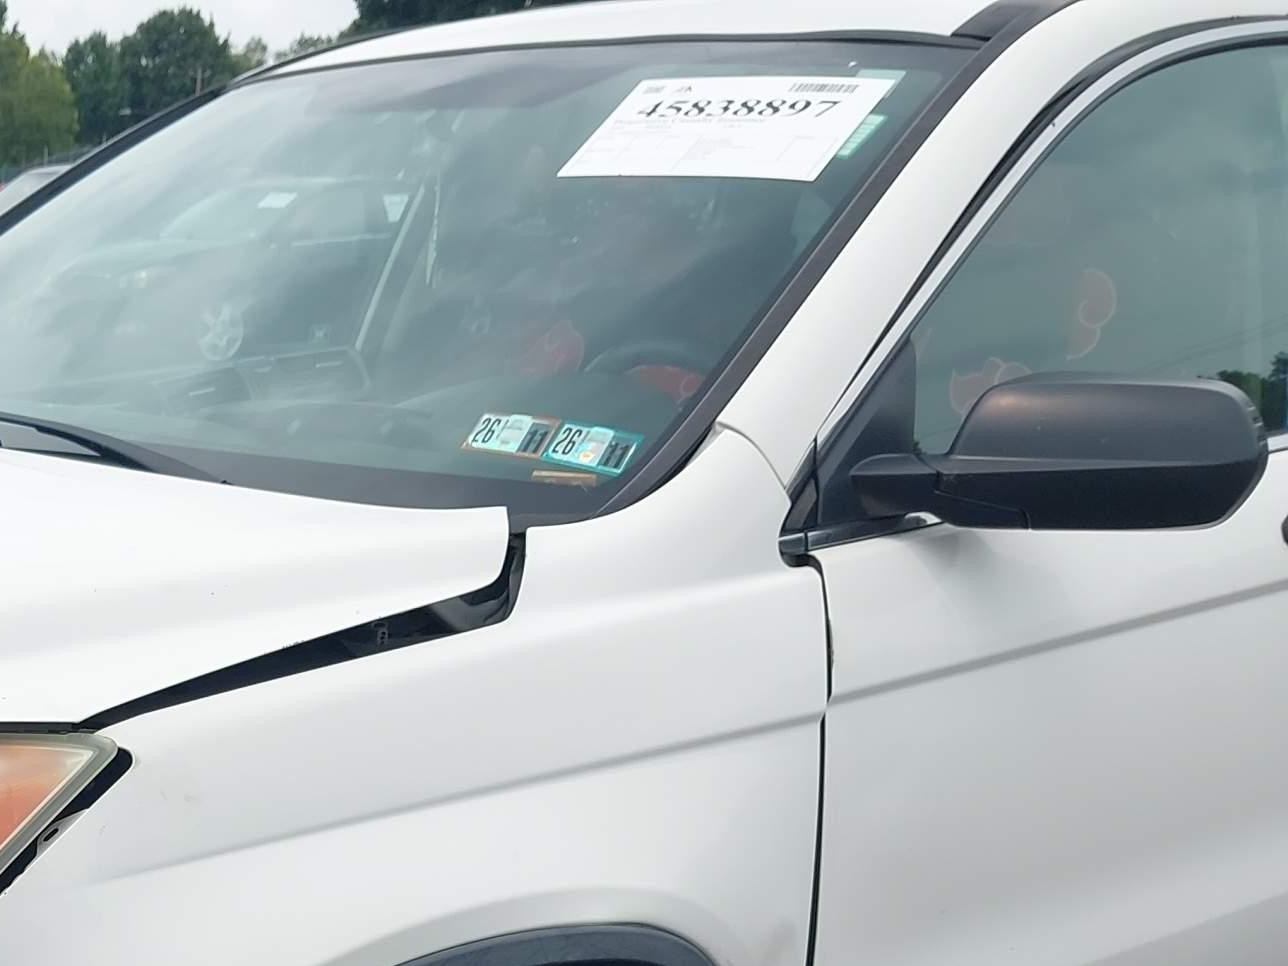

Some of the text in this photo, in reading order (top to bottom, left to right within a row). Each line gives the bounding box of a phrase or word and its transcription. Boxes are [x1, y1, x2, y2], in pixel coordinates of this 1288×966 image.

[637, 98, 842, 118] 45838897
[472, 417, 502, 444] 26
[552, 426, 583, 455] 26
